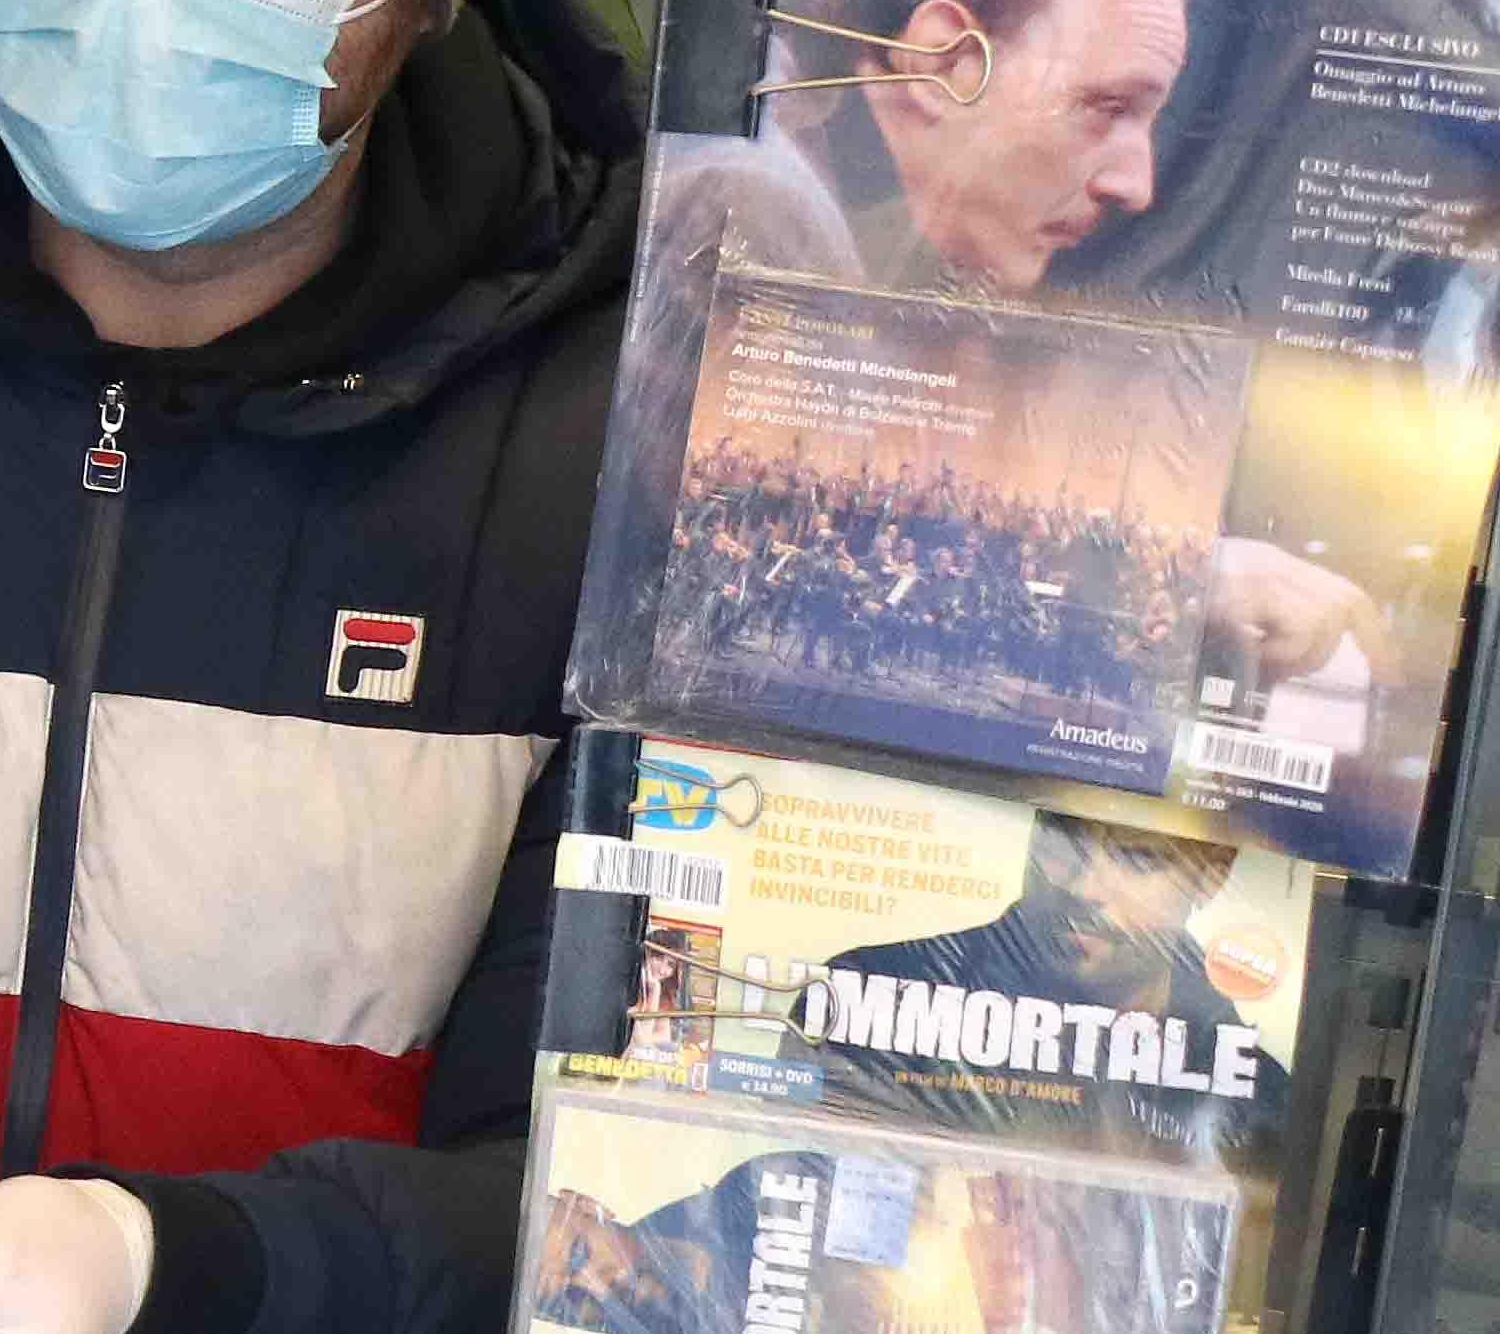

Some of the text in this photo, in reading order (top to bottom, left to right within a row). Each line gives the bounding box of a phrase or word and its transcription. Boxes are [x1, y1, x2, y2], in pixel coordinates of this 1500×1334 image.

[732, 343, 957, 388] Arturo Benedetti Michelangeli
[1048, 718, 1148, 754] Amadeus
[761, 793, 935, 833] SOPRAVVIVERE
[749, 878, 897, 916] INVINCIBILI?
